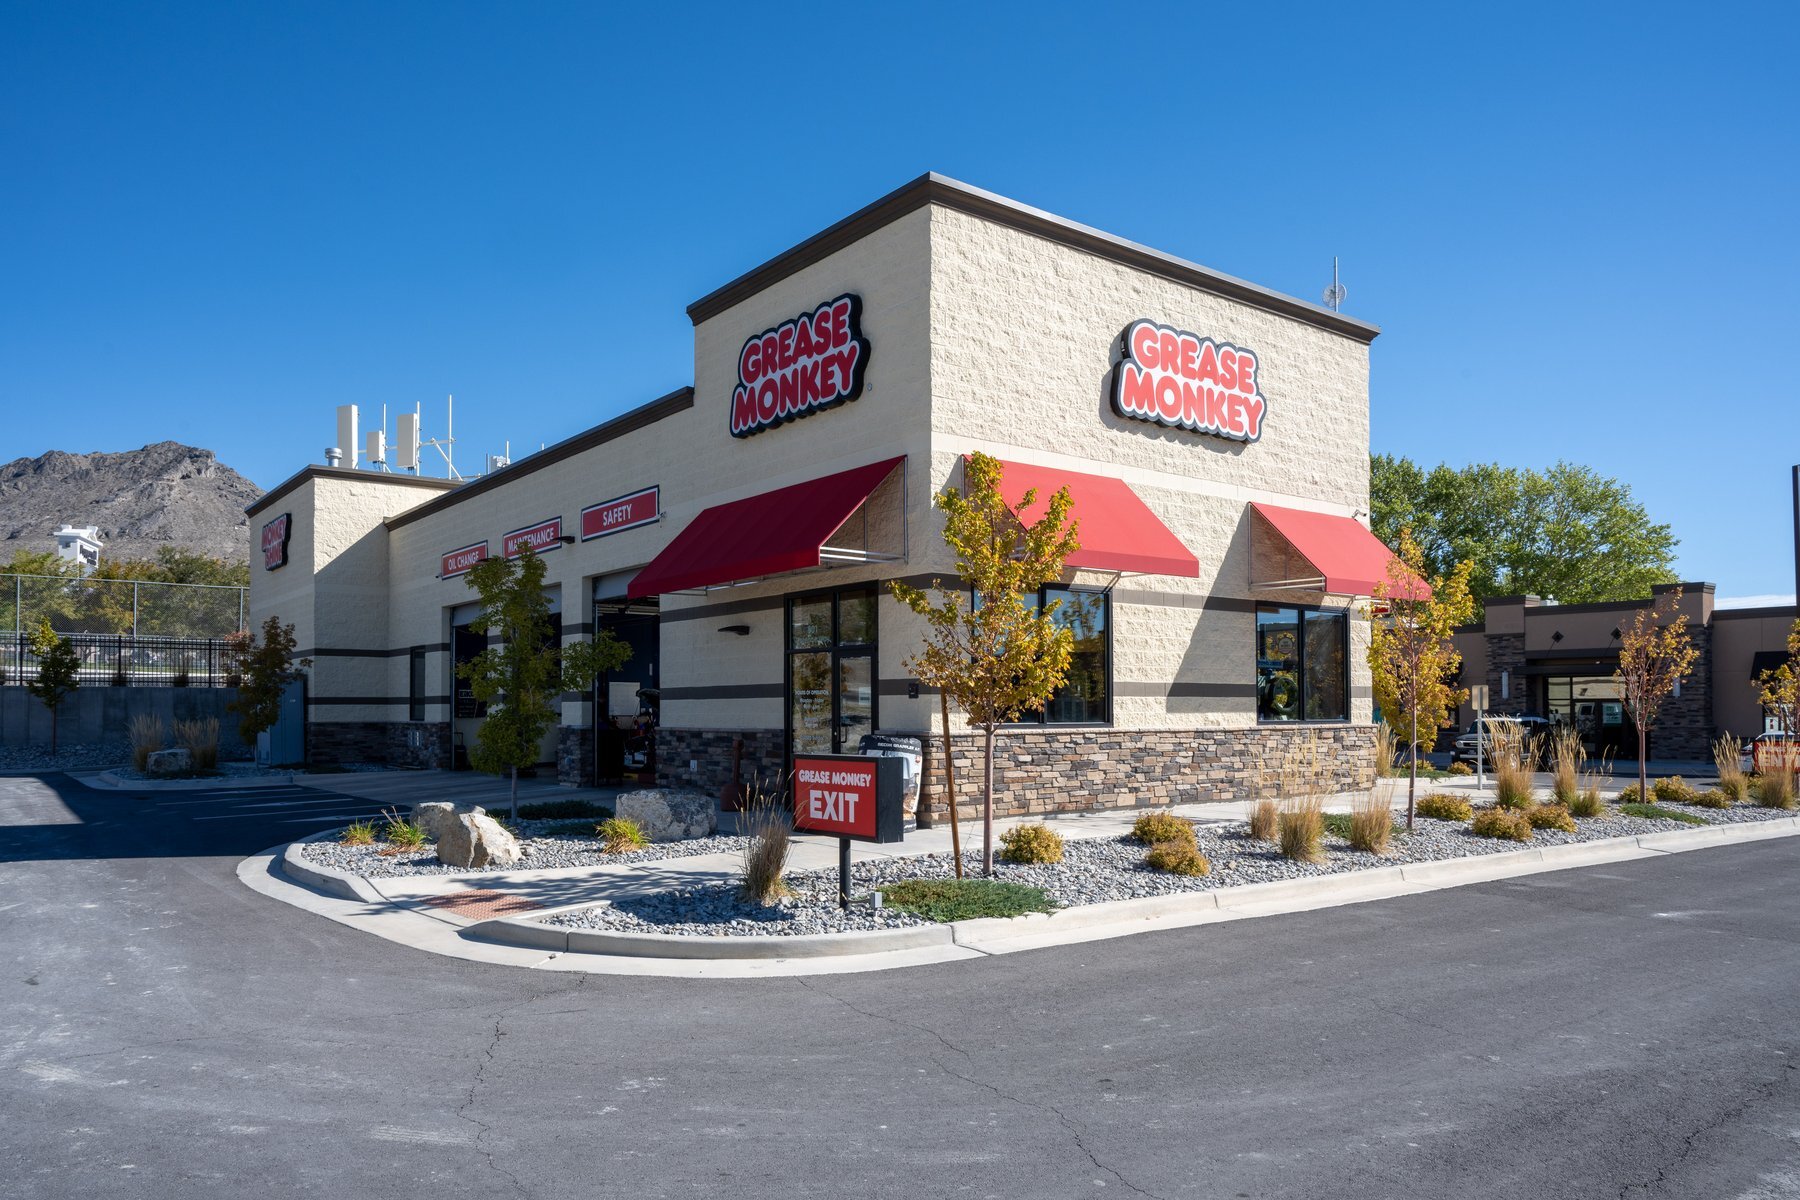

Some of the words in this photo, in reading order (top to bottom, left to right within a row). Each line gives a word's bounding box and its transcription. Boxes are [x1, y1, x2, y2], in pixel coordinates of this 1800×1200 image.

[741, 301, 849, 384] GREASE
[1133, 326, 1254, 394] GREASE
[733, 344, 857, 430] MONKEY
[1122, 366, 1263, 436] MONKEY
[602, 503, 632, 527] SAFETY
[447, 557, 457, 571] OIL
[457, 551, 479, 568] CHANGE
[798, 769, 830, 784] GREASE
[832, 772, 872, 787] MONKEY
[809, 789, 859, 824] EXIT
